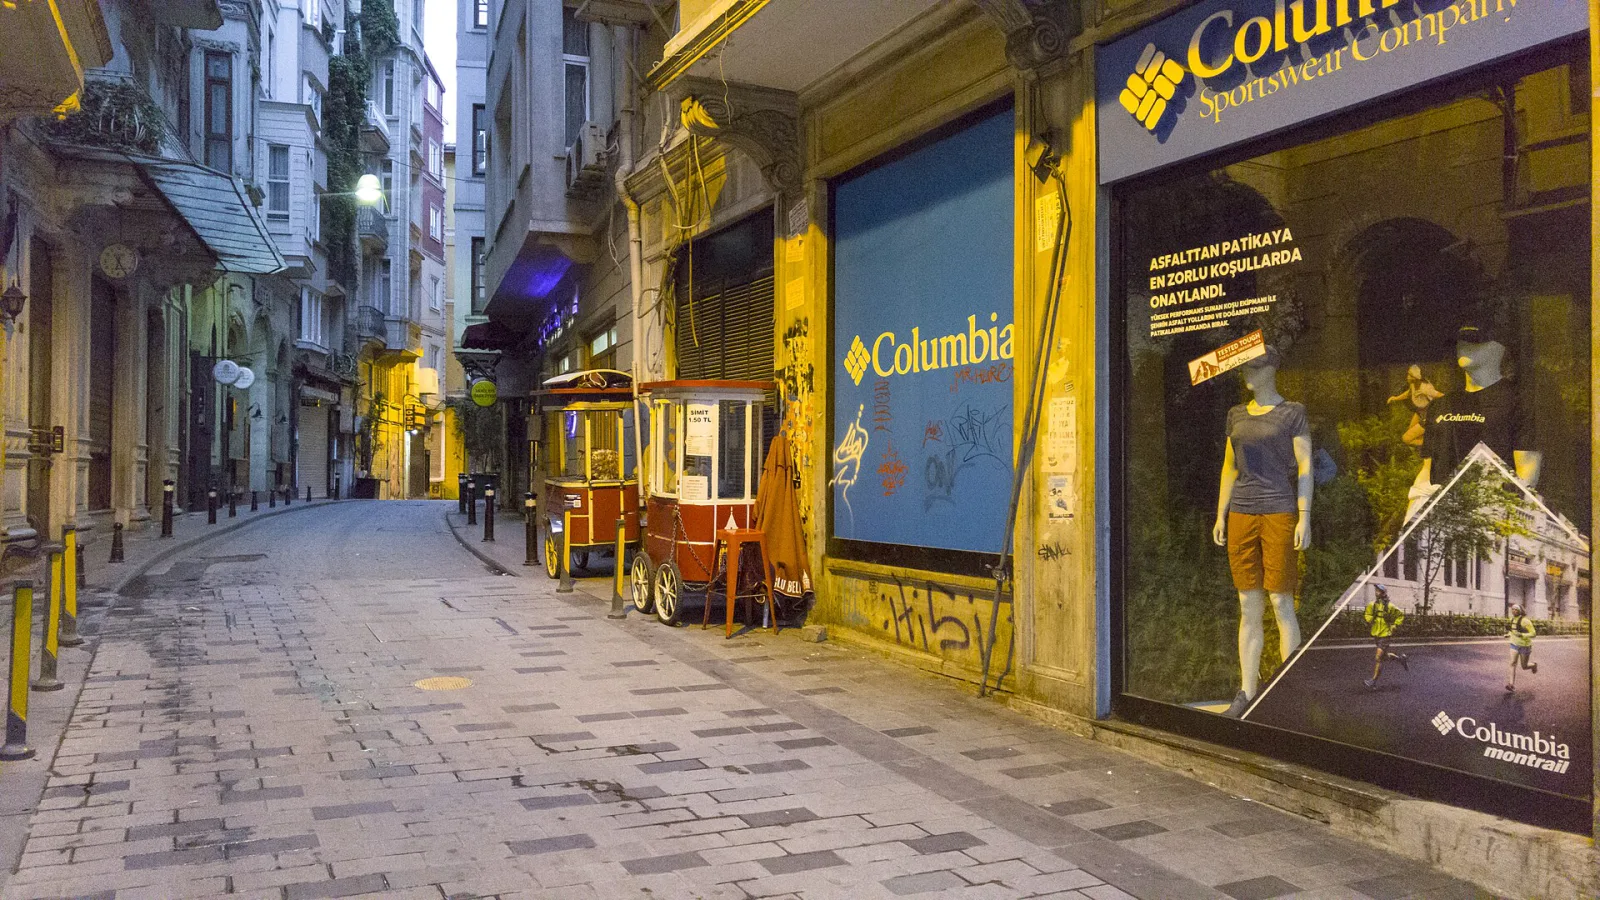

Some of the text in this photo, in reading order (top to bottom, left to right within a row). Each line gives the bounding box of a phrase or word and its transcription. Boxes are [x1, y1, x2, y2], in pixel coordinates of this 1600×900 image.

[1199, 46, 1349, 124] Sportswear
[1150, 227, 1293, 271] ASFALTTAN PATİKAYA
[1150, 247, 1303, 290] EN ZORLU KOŞULLARDA
[1150, 283, 1226, 309] ONAYLANDI.
[1250, 304, 1270, 314] ZORLU
[872, 312, 1014, 377] Columbia
[1217, 332, 1261, 357] TESTED TOUGH
[1443, 413, 1485, 423] Columbia
[1456, 717, 1570, 759] Columbia
[1483, 746, 1570, 774] montrail
